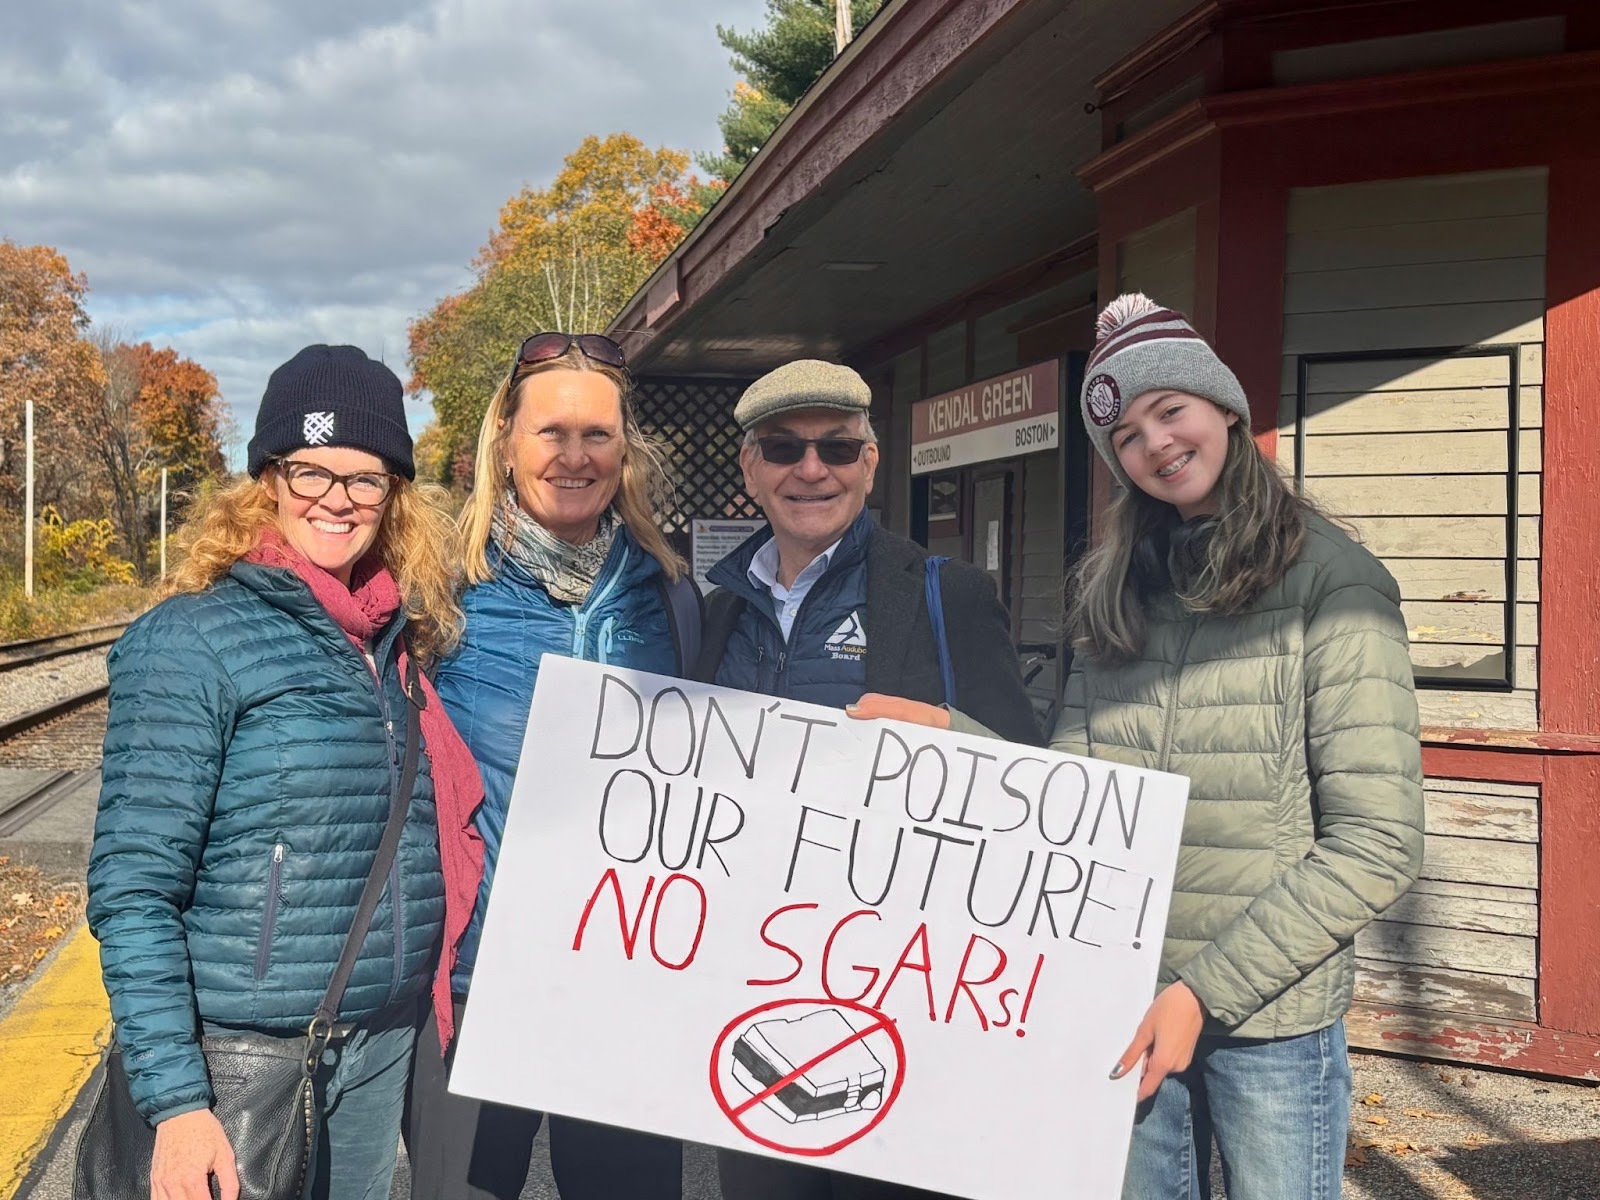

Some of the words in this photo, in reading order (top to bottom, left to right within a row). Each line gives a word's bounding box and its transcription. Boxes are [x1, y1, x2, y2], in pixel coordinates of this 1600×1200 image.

[928, 391, 979, 435] KENDAL
[981, 373, 1034, 422] GREEN
[1091, 382, 1113, 416] W
[1015, 422, 1049, 447] BOSTON
[917, 445, 951, 467] OUTBOUND
[823, 643, 841, 652] Mass
[840, 644, 868, 655] Audubo
[831, 651, 862, 662] Board
[590, 673, 838, 794] DON'T
[863, 727, 1146, 851] POISON
[598, 768, 747, 878] OUR
[783, 804, 1154, 951] FUTURE!
[572, 867, 708, 971] NO
[745, 902, 1046, 1038] SGARs!
